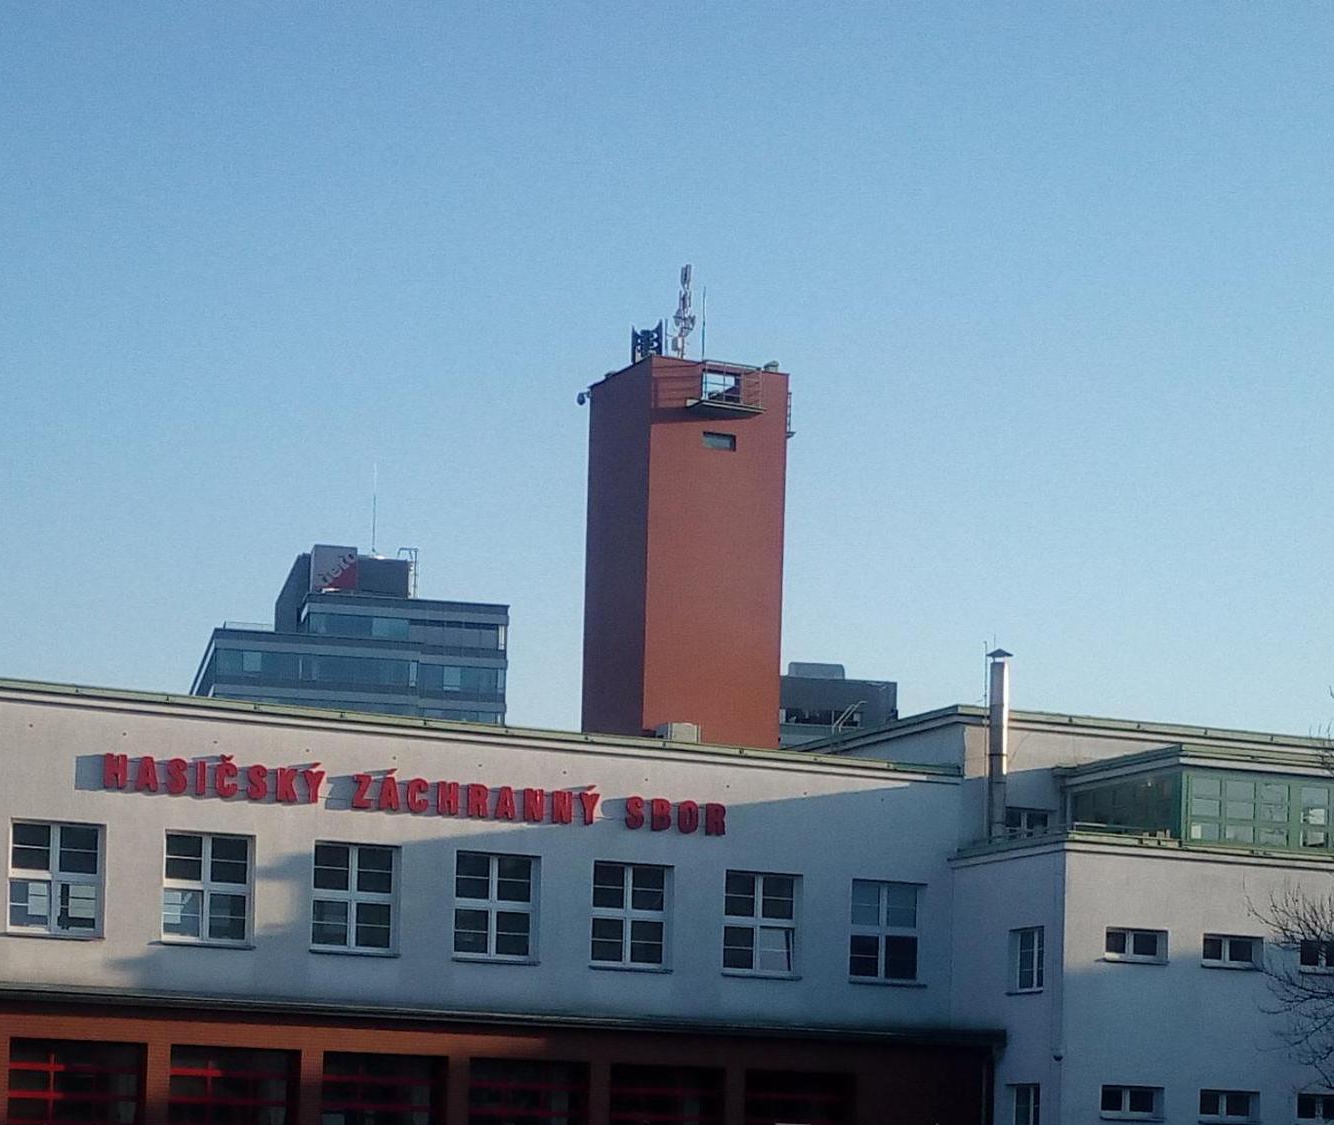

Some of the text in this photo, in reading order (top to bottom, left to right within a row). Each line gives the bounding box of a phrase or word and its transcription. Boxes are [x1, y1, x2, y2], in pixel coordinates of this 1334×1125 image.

[102, 753, 727, 836] HASIČSKÝ ZÁCHRANNÝ SBOR
